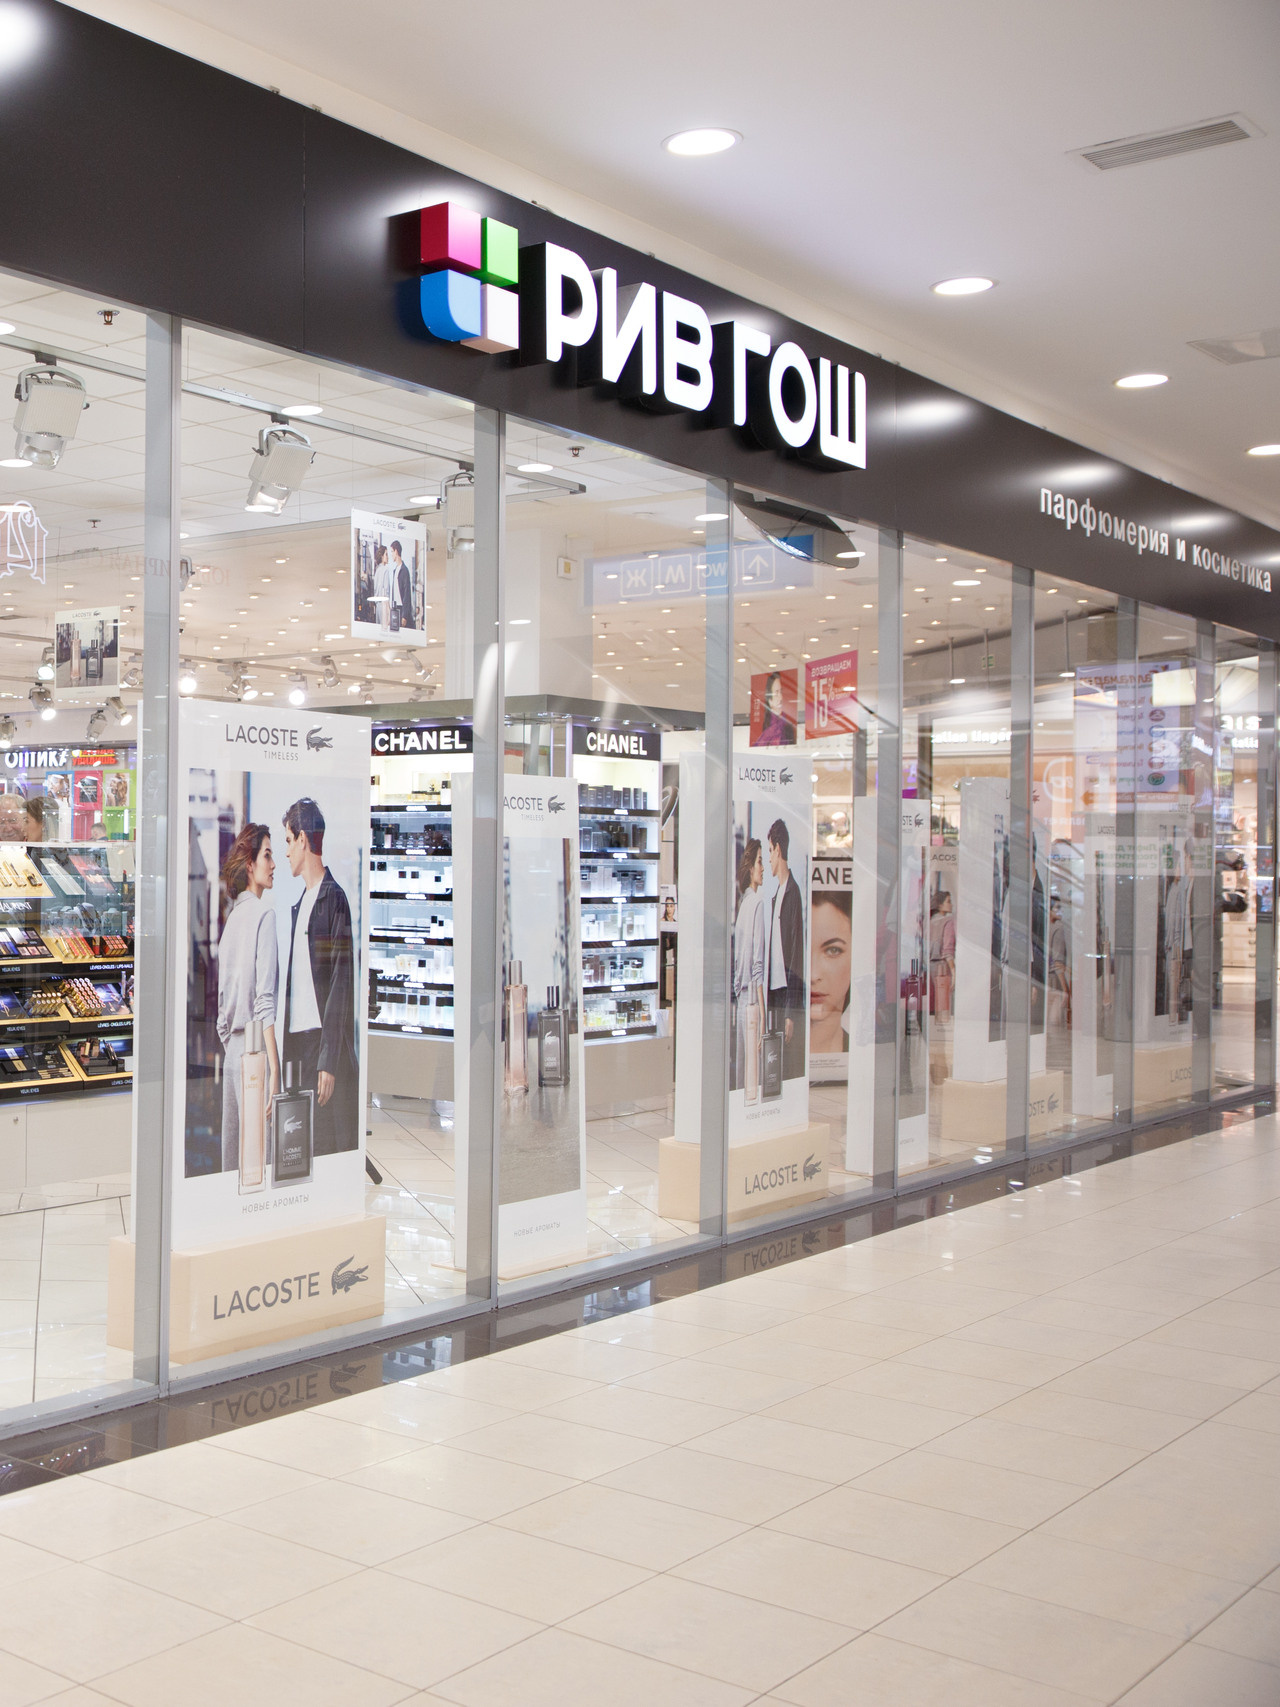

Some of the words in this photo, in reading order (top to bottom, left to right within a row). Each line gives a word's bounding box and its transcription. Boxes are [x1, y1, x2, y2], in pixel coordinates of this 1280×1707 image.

[545, 242, 713, 412] РИВ
[733, 321, 867, 470] ГОШ
[1040, 488, 1169, 555] парфюмерия
[1176, 538, 1186, 562] и
[1192, 544, 1272, 593] косметика
[226, 724, 298, 747] LACOSTE
[374, 730, 467, 752] CHANEL
[586, 731, 648, 756] CHANEL
[264, 751, 299, 761] TIMELESS
[739, 767, 776, 782] LACOSTE
[503, 796, 544, 811] ACOSTE
[931, 853, 957, 862] ACOS
[812, 867, 853, 885] ANE
[1170, 1066, 1192, 1083] LACOS
[1028, 1099, 1045, 1117] OSTE
[745, 1164, 798, 1195] LACOSTE
[242, 1201, 270, 1214] НОВЫЕ
[273, 1194, 309, 1210] АРОМАТЫ
[514, 1227, 535, 1238] НОВЫЕ
[537, 1222, 561, 1234] АРОМАТЫ
[213, 1271, 320, 1321] LACOSTE
